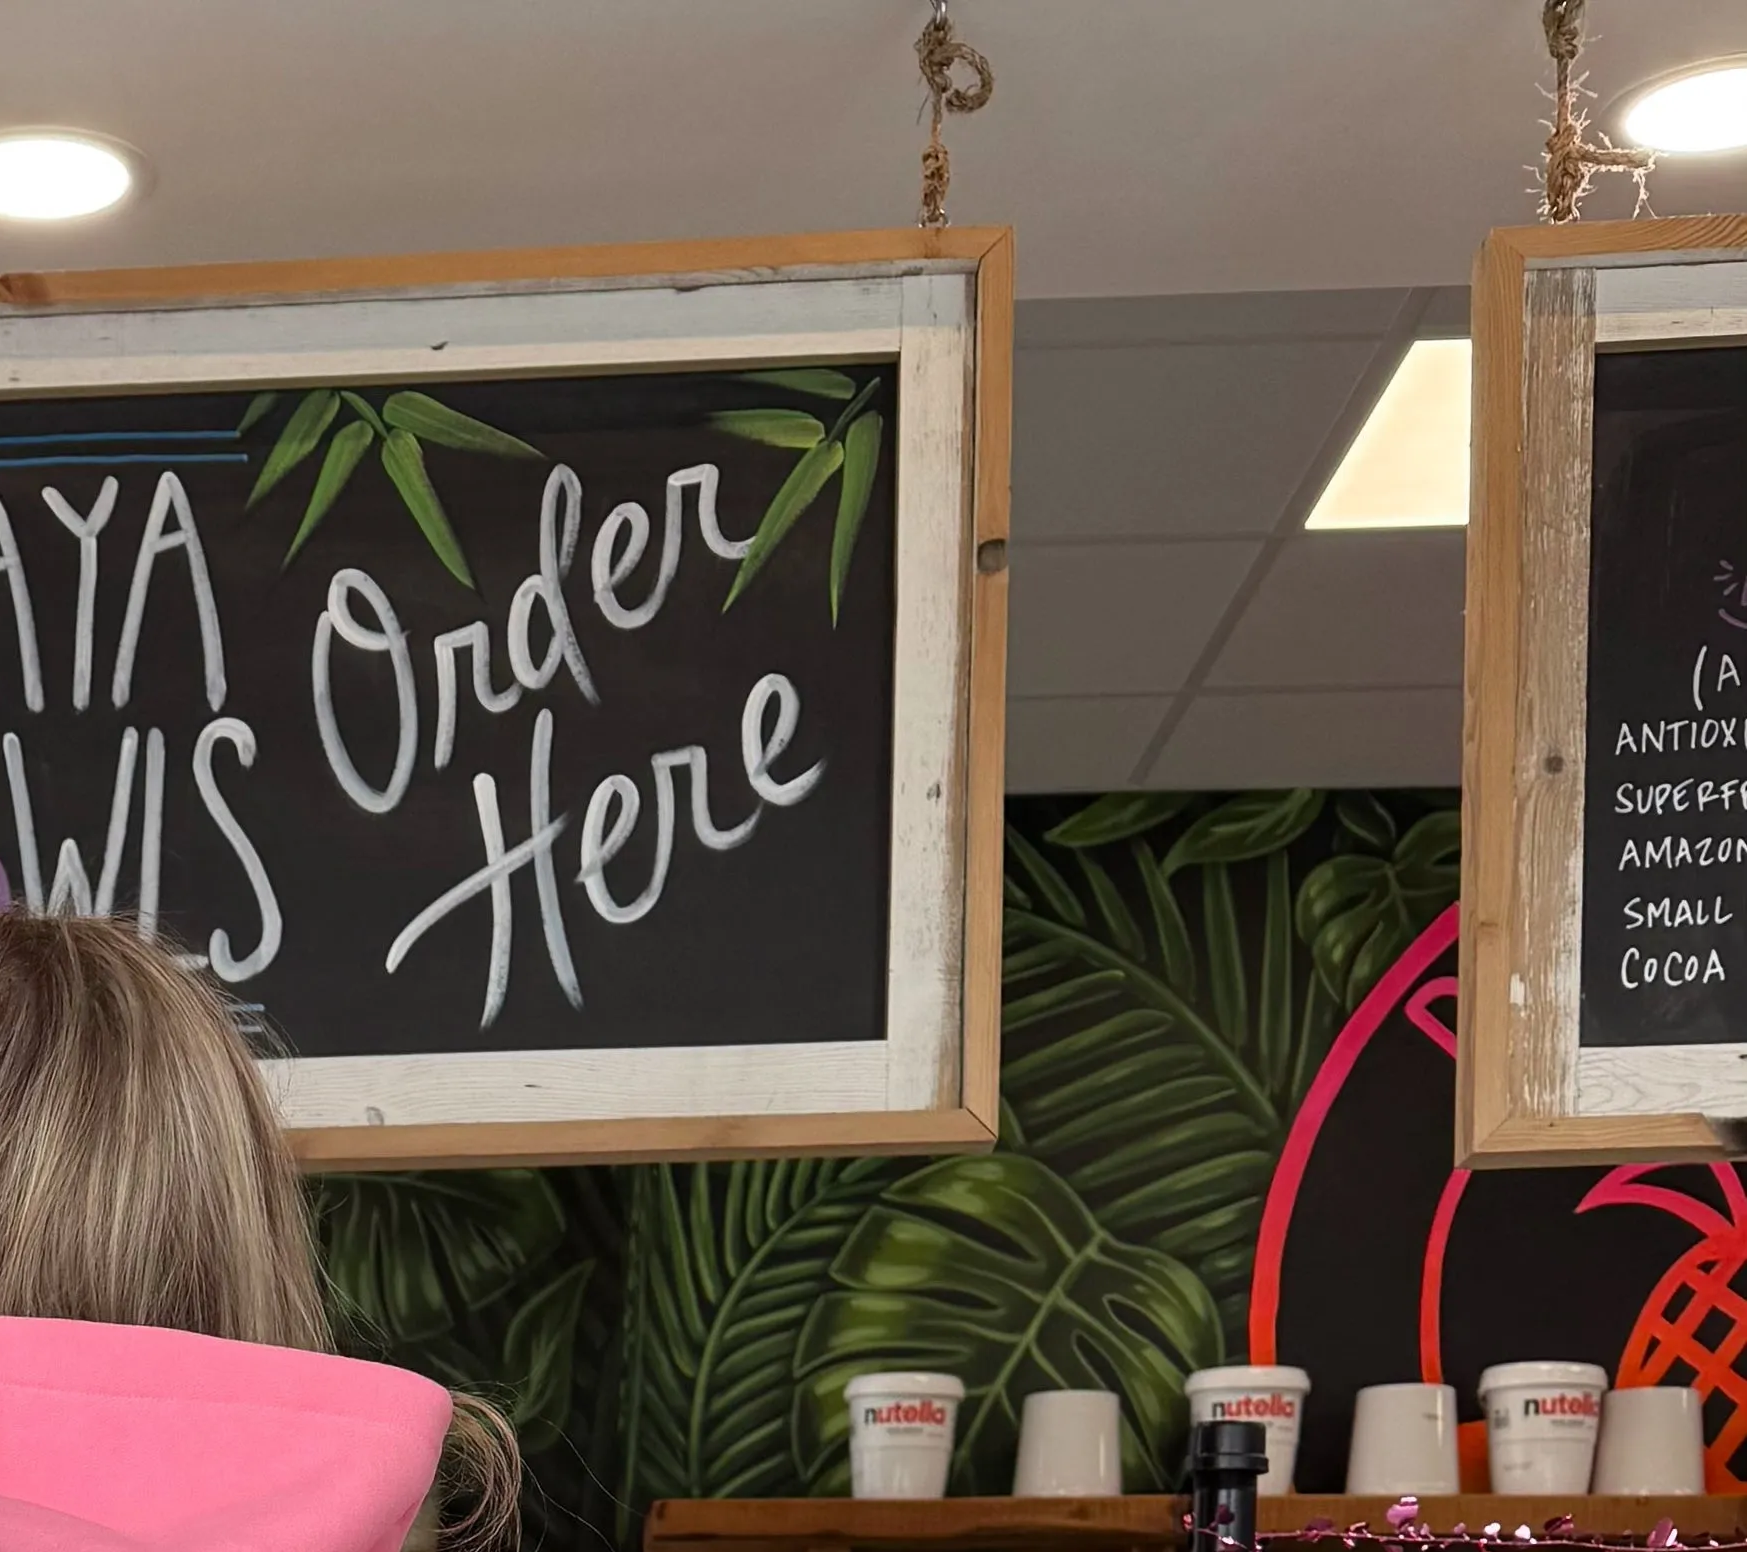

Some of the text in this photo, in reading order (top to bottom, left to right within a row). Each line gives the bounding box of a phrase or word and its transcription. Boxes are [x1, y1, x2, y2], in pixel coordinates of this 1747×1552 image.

[312, 463, 757, 814] Order
[385, 672, 828, 1030] Here
[1623, 896, 1734, 930] SMALL
[1621, 947, 1725, 989] COCOA
[864, 1399, 946, 1425] nutella
[1212, 1392, 1295, 1418] nutella
